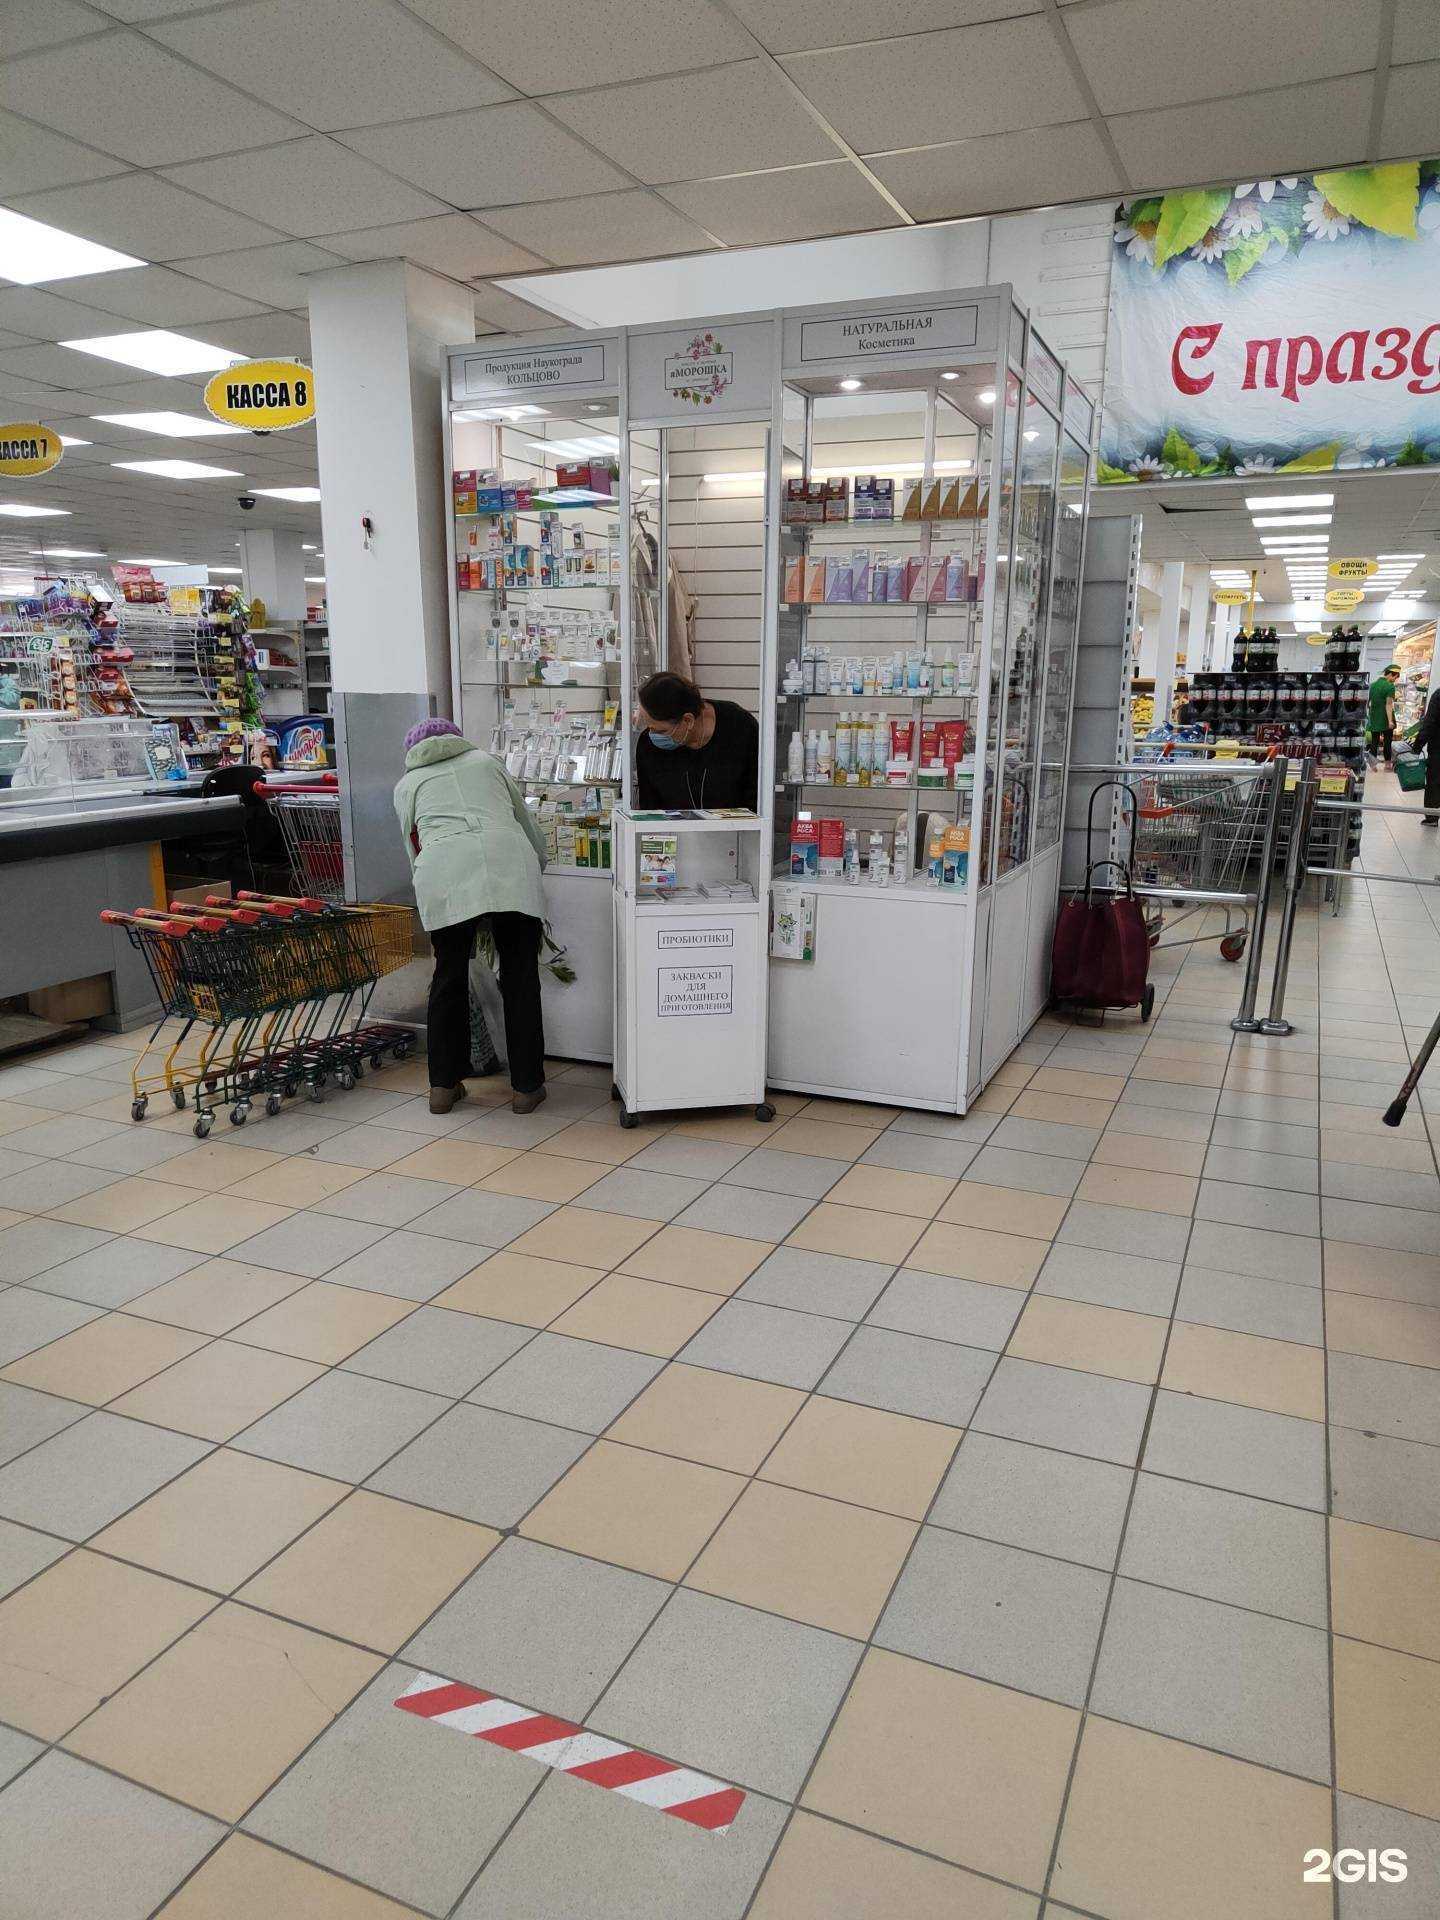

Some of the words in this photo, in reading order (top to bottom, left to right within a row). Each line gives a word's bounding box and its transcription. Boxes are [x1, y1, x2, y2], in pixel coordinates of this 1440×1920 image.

[843, 317, 932, 336] НАТУРАЛЬНАЯ
[858, 337, 916, 350] Косметика
[485, 361, 532, 375] Продукция
[533, 355, 583, 370] Наукограда
[1171, 322, 1224, 396] С
[507, 370, 560, 385] КОЛЬЦОВО
[226, 382, 291, 409] КАССА
[294, 381, 307, 407] 8
[0, 439, 39, 460] АССА
[40, 438, 48, 458] 7
[662, 934, 729, 945] ПРОБИОТИКИ
[671, 971, 722, 982] ЗАКВАСКИ
[686, 982, 706, 992] ДЛЯ
[663, 992, 729, 1003] ДОМАШНЕГО
[660, 1002, 731, 1012] ПРИГОТОВЛЕНИЯ
